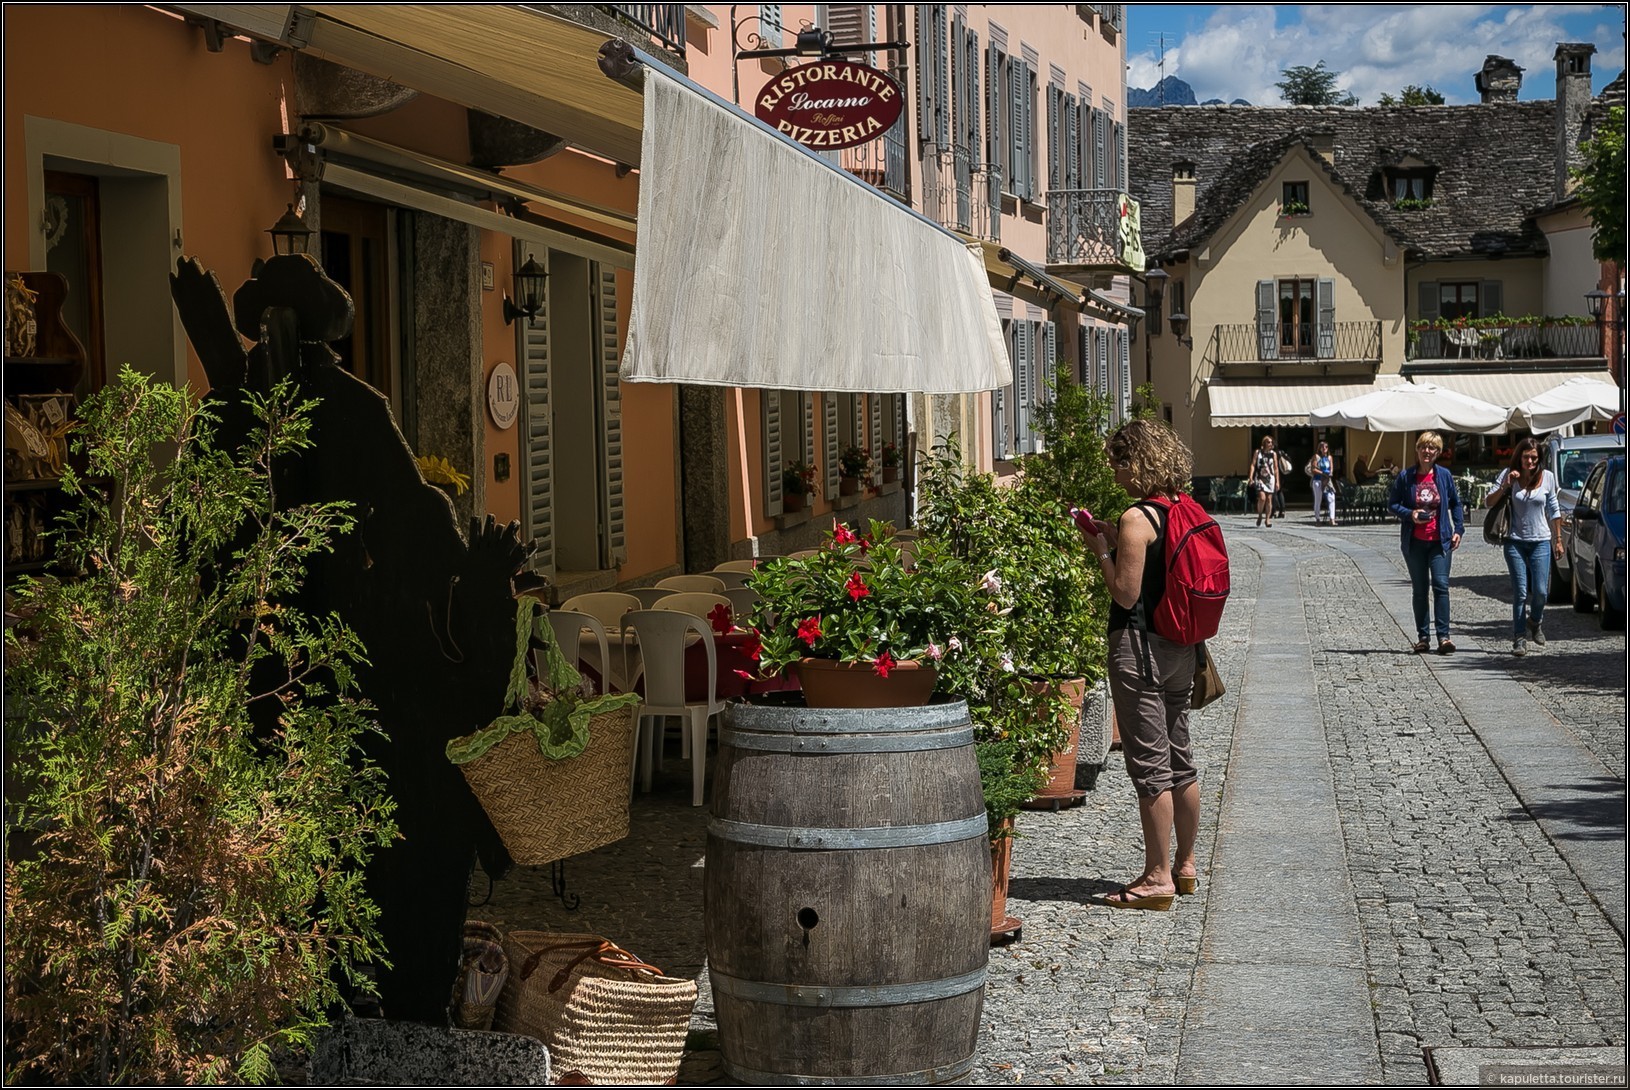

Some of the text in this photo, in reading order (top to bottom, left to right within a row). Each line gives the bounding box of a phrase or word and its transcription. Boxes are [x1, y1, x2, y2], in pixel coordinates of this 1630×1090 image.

[760, 65, 895, 112] RISTORANTE
[788, 92, 873, 111] Locarno
[777, 116, 883, 145] PIZZERIA
